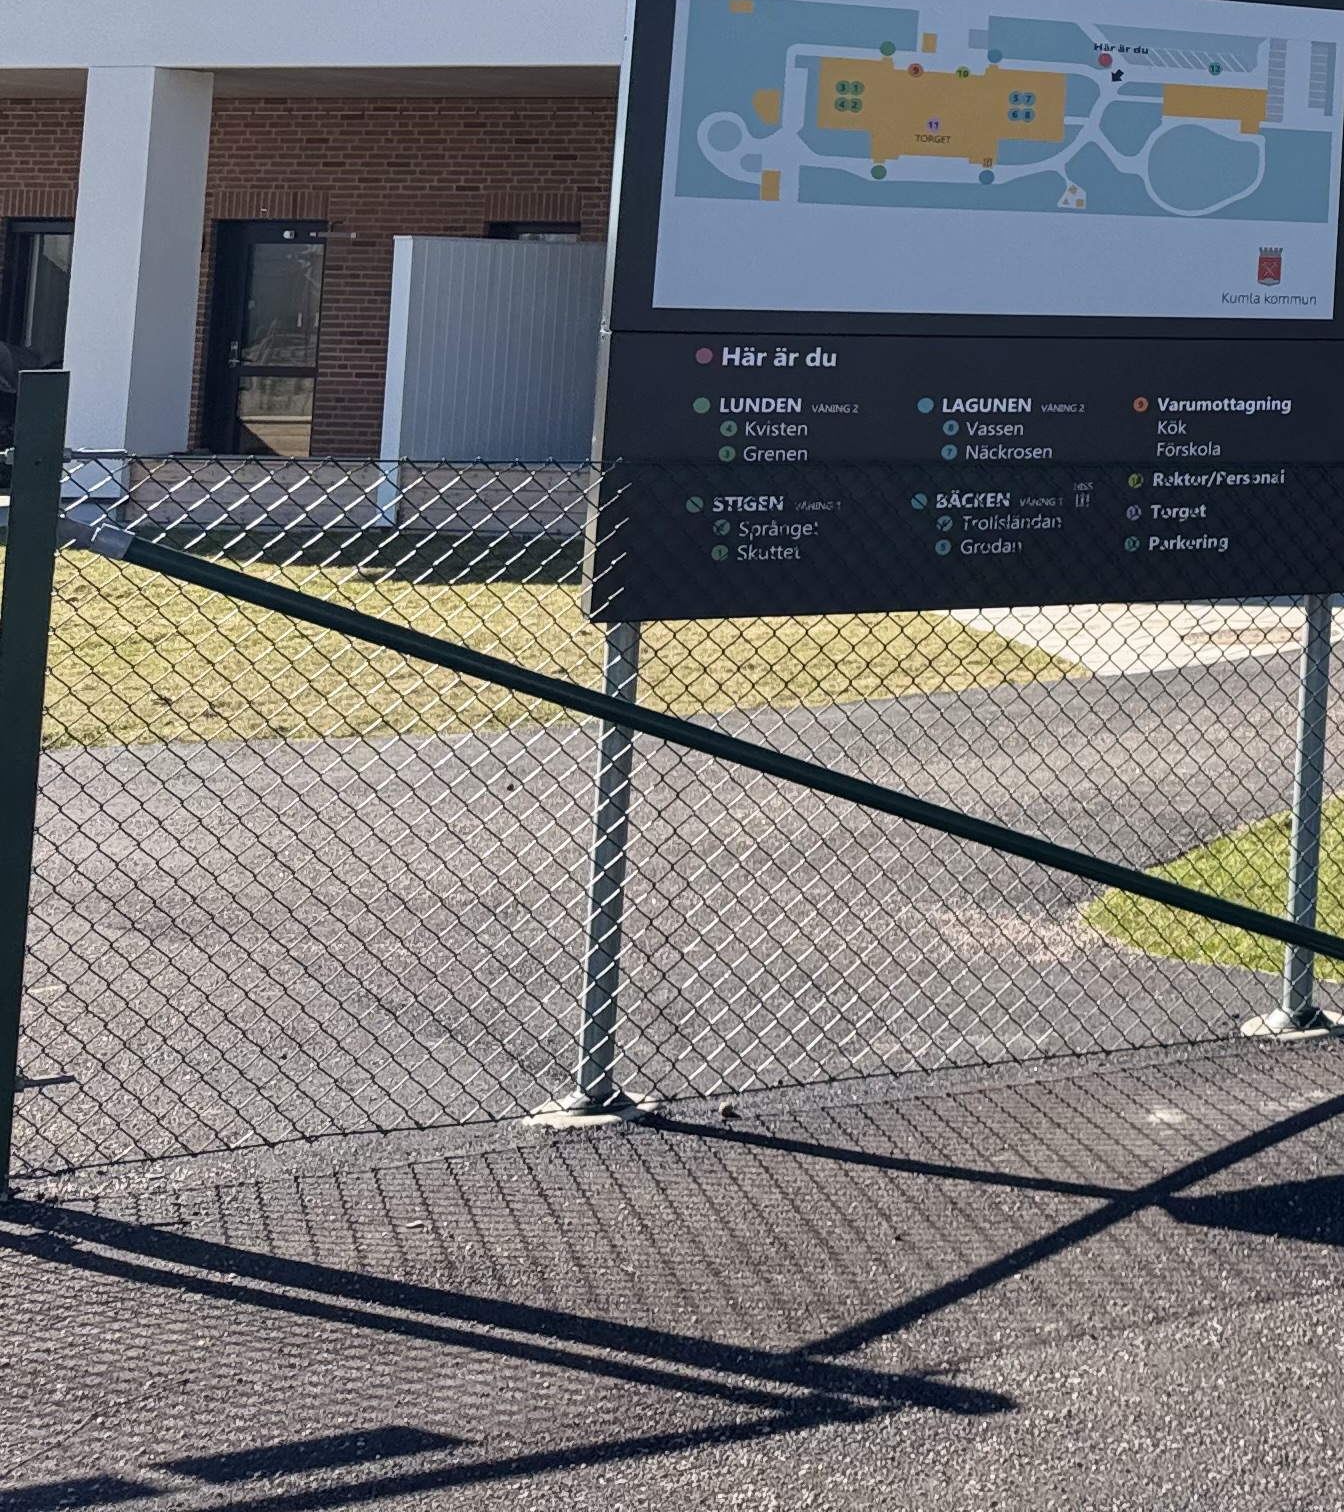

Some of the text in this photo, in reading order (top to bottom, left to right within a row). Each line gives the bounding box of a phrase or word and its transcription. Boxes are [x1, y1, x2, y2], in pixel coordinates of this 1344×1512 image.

[1094, 43, 1149, 54] Här är du
[956, 69, 969, 78] 10
[928, 121, 939, 129] 11
[914, 133, 951, 144] TORGET
[1221, 292, 1317, 305] Kumla kommun
[721, 347, 837, 367] Här är du
[719, 397, 802, 413] LUNDEN
[942, 397, 1032, 413] LAGUNEN
[1157, 396, 1292, 414] Varumottagning
[744, 420, 808, 436] Kvisten
[965, 421, 1024, 436] Vassen
[1157, 420, 1187, 435] Kök
[743, 445, 808, 462] Grenen
[965, 444, 1053, 460] Näckrosen
[1156, 441, 1221, 457] Förskola
[1153, 469, 1285, 487] Rektor/Personal
[712, 495, 784, 512] STIGEN
[936, 490, 1011, 508] BÄCKEN
[1150, 503, 1207, 522] Torget
[738, 519, 819, 540] Språnget
[960, 538, 1023, 554] Grodan
[1149, 534, 1229, 552] Parkering
[737, 544, 801, 561] Skuttet
